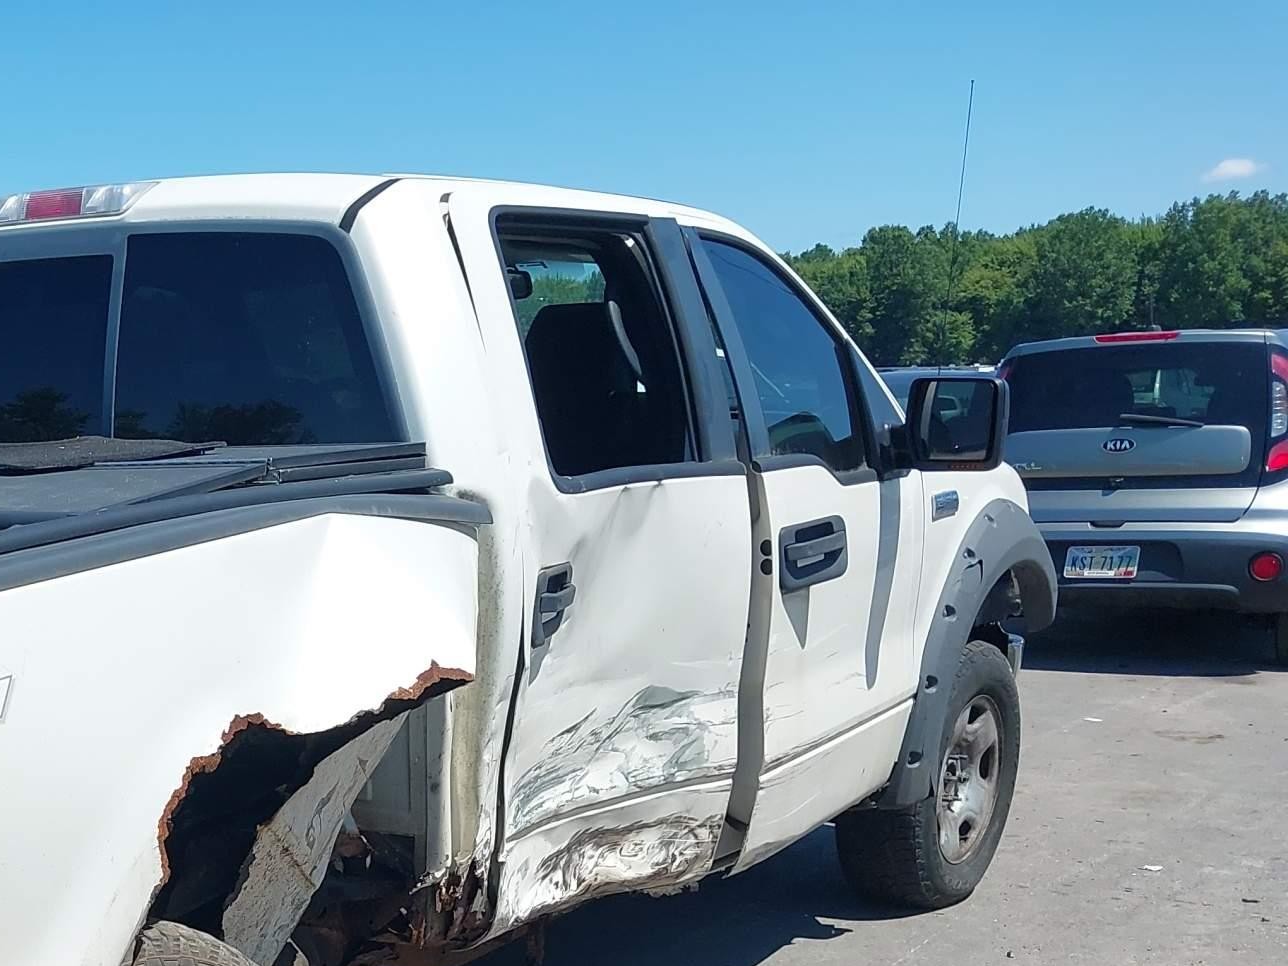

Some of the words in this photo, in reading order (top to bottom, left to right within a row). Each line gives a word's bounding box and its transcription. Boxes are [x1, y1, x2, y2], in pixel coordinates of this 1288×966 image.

[1107, 440, 1130, 450] KIA
[1071, 556, 1095, 571] KST
[1101, 556, 1133, 571] 7177
